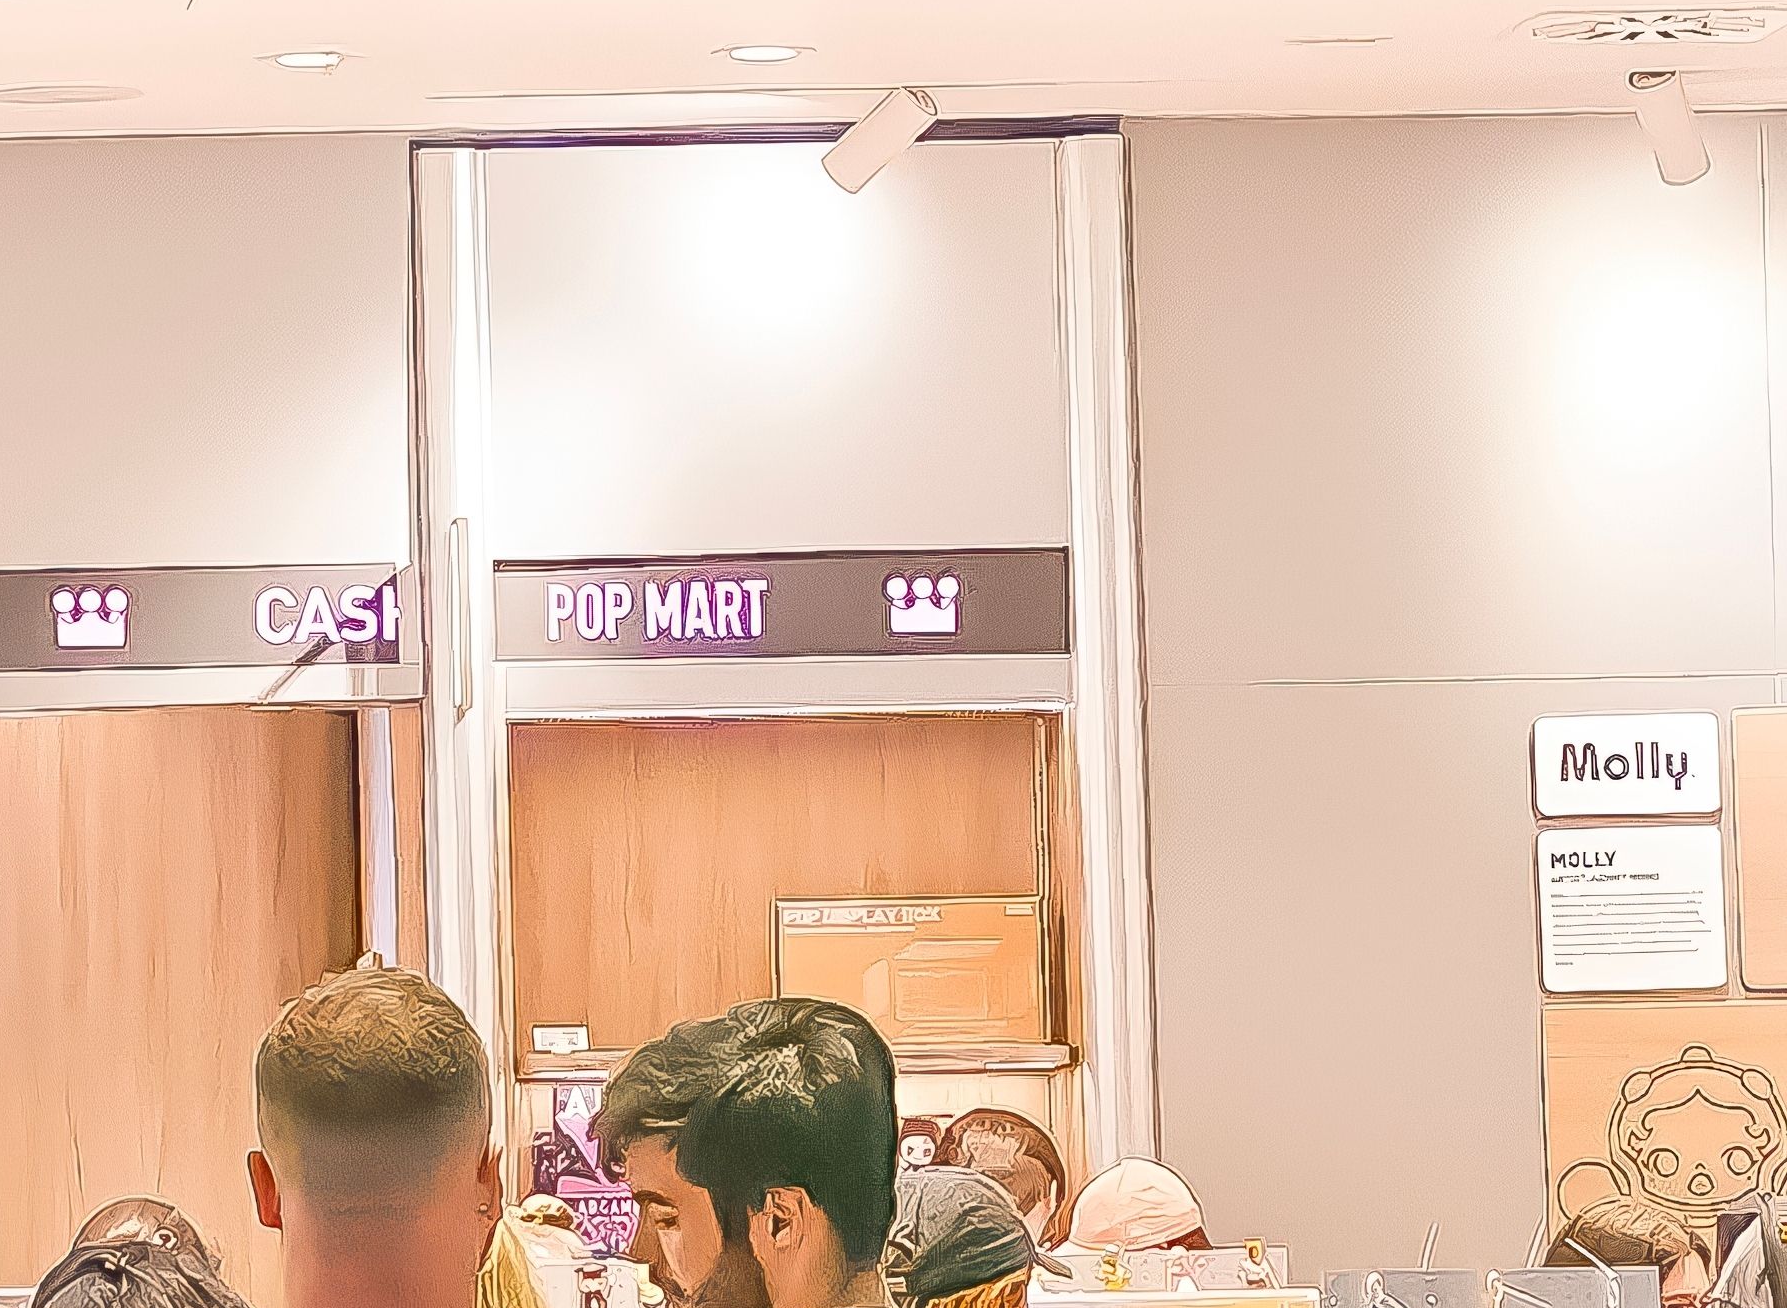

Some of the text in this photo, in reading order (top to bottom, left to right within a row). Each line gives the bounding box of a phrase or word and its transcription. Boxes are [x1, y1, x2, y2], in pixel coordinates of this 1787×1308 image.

[547, 577, 772, 642] POP MART
[1560, 740, 1689, 790] Molly
[1550, 850, 1617, 869] MOLLY
